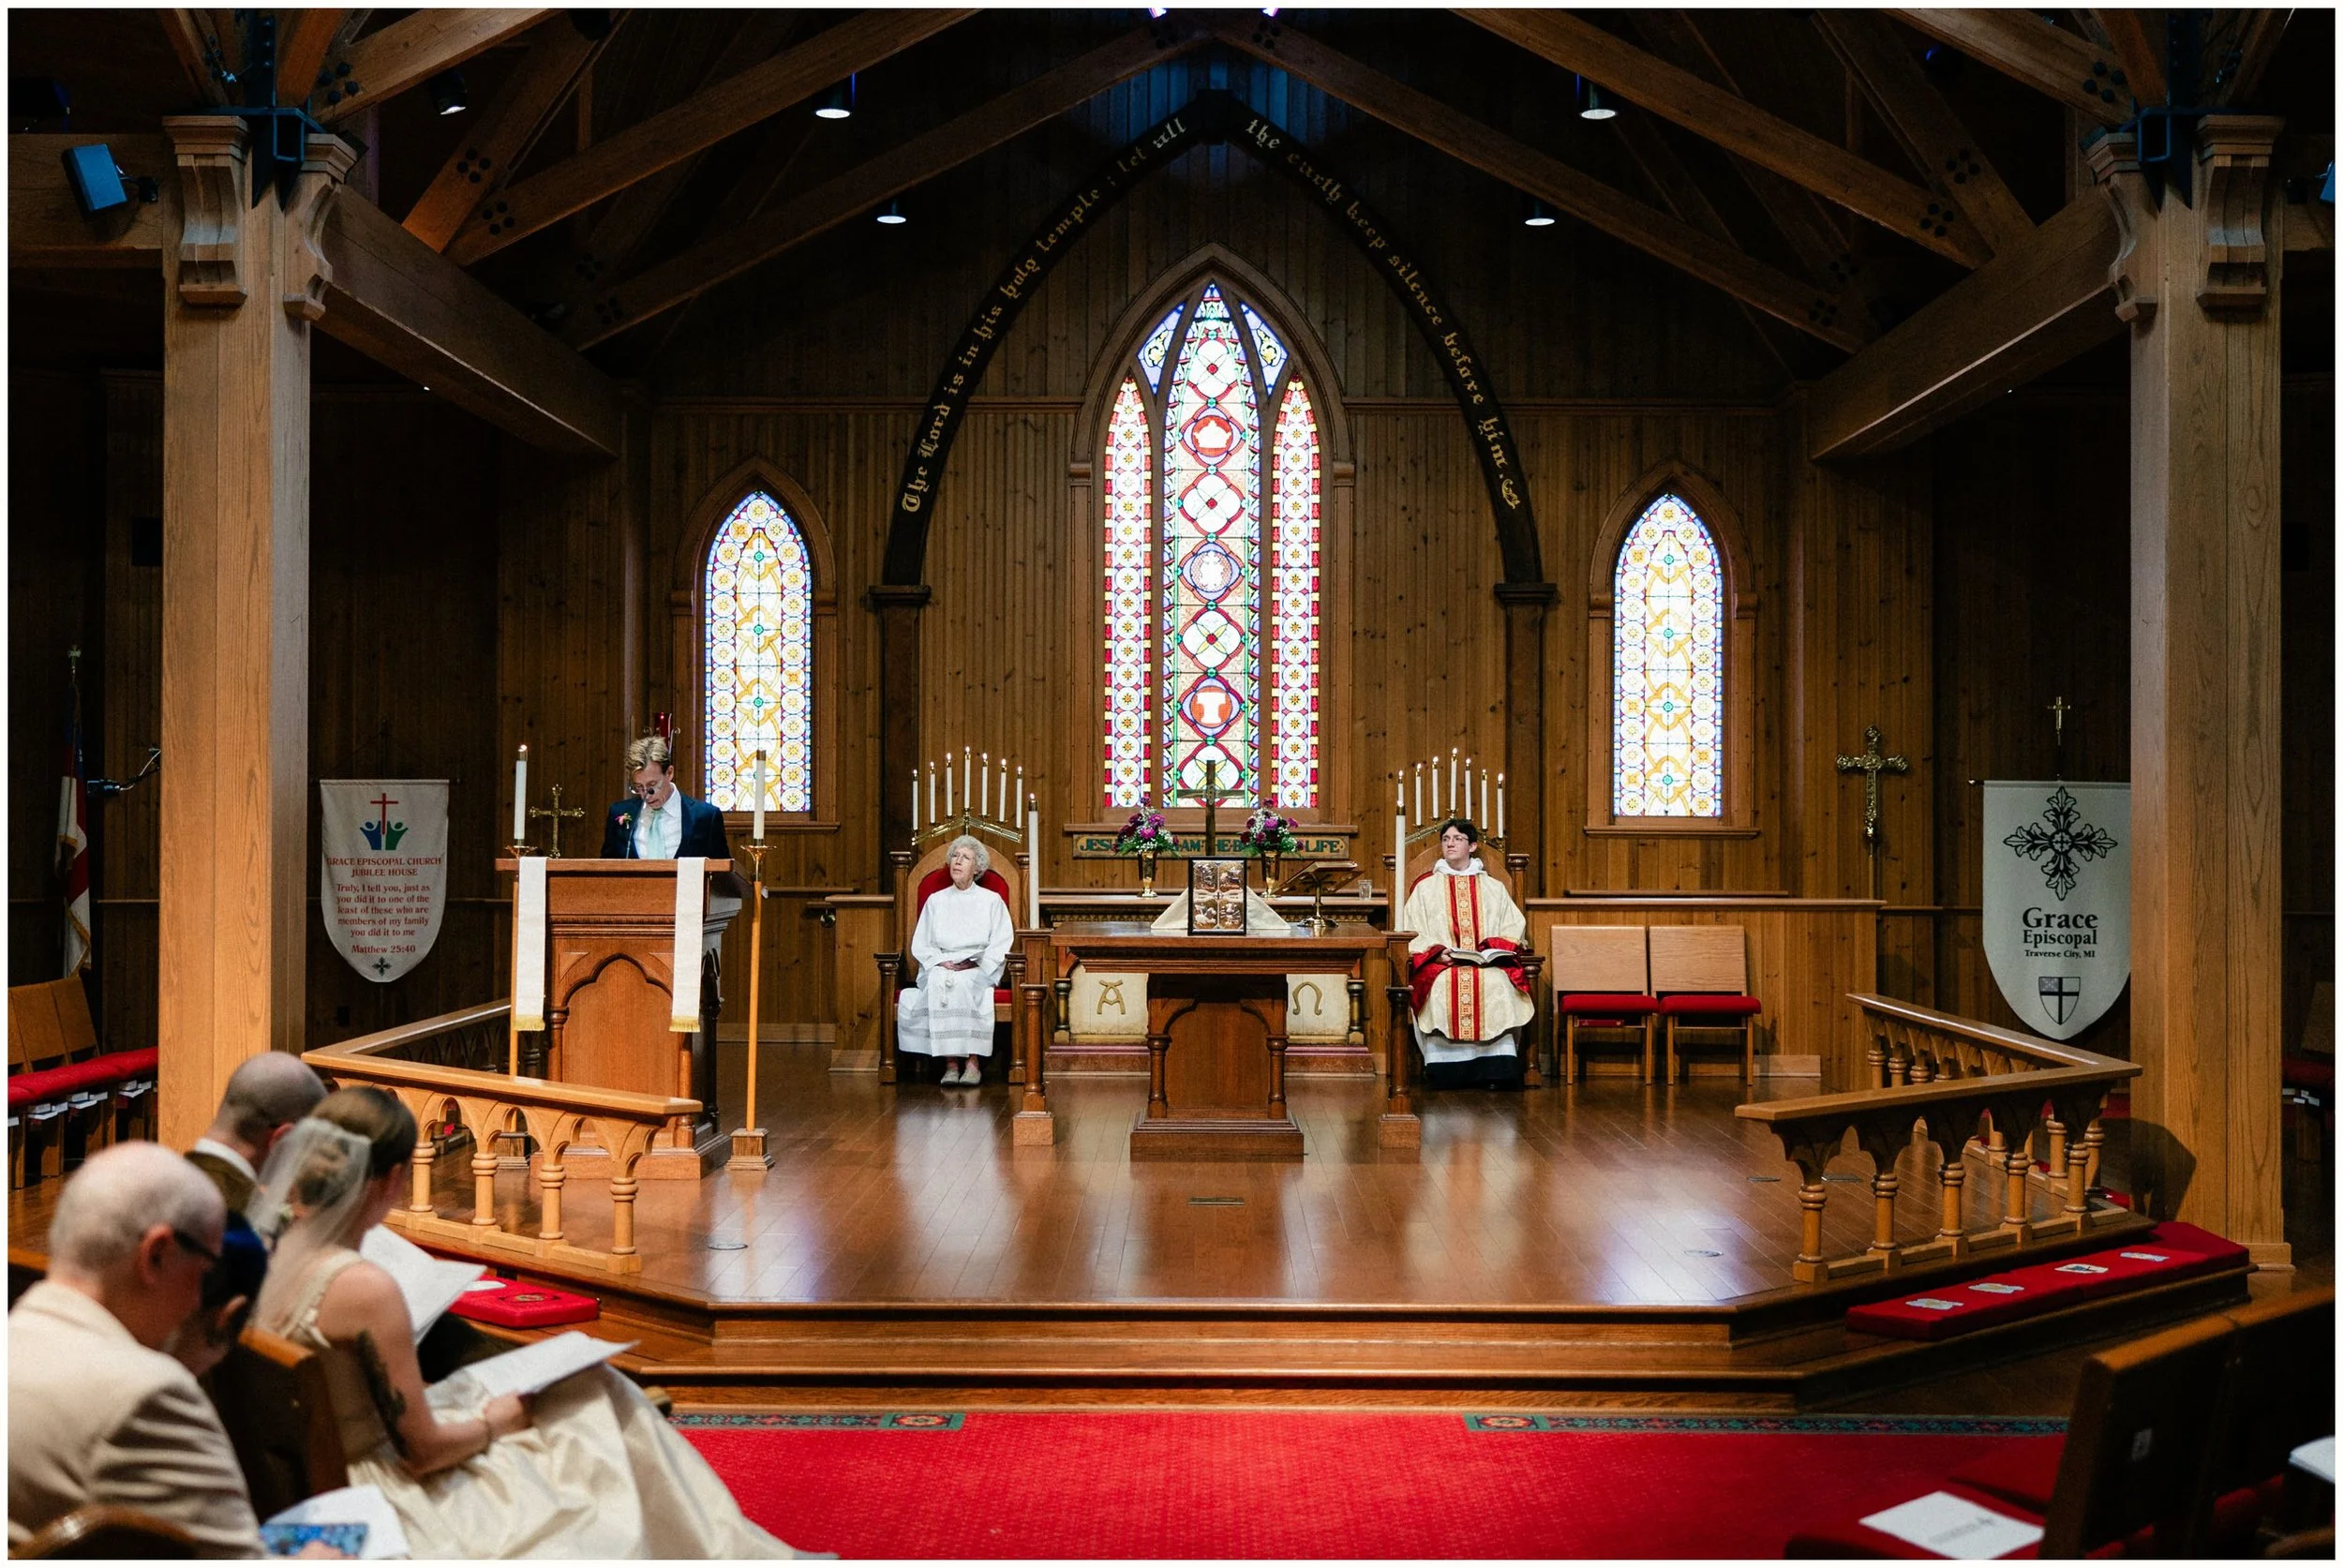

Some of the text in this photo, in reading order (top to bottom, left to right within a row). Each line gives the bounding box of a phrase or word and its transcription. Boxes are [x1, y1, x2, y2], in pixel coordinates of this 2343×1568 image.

[902, 466, 929, 513] The
[917, 402, 951, 458] Lord
[944, 373, 964, 396] is
[959, 344, 979, 367] in
[973, 306, 1003, 341] his
[999, 255, 1040, 299] holy
[1153, 117, 1186, 148] all
[1245, 119, 1282, 149] the
[1287, 153, 1344, 205] earth
[1346, 201, 1388, 249] keep
[1387, 254, 1442, 326] silence
[1440, 332, 1485, 405] before
[1306, 840, 1340, 853] LIFE
[357, 857, 404, 866] EPISCOPAL
[407, 857, 441, 865] CHURCH
[351, 868, 418, 877] JUBILEE HOUSE
[337, 884, 360, 893] Truly,
[383, 885, 401, 893] you,
[404, 884, 419, 893] just
[336, 895, 351, 904] you
[337, 917, 376, 925] members
[389, 918, 402, 927] my
[404, 917, 429, 927] family
[2022, 907, 2098, 929] Grace
[351, 929, 366, 937] you
[368, 928, 381, 936] did
[2022, 929, 2097, 948] Episcopal
[351, 945, 416, 954] Matthew 25:40
[2024, 949, 2096, 959] Traverse City, MI
